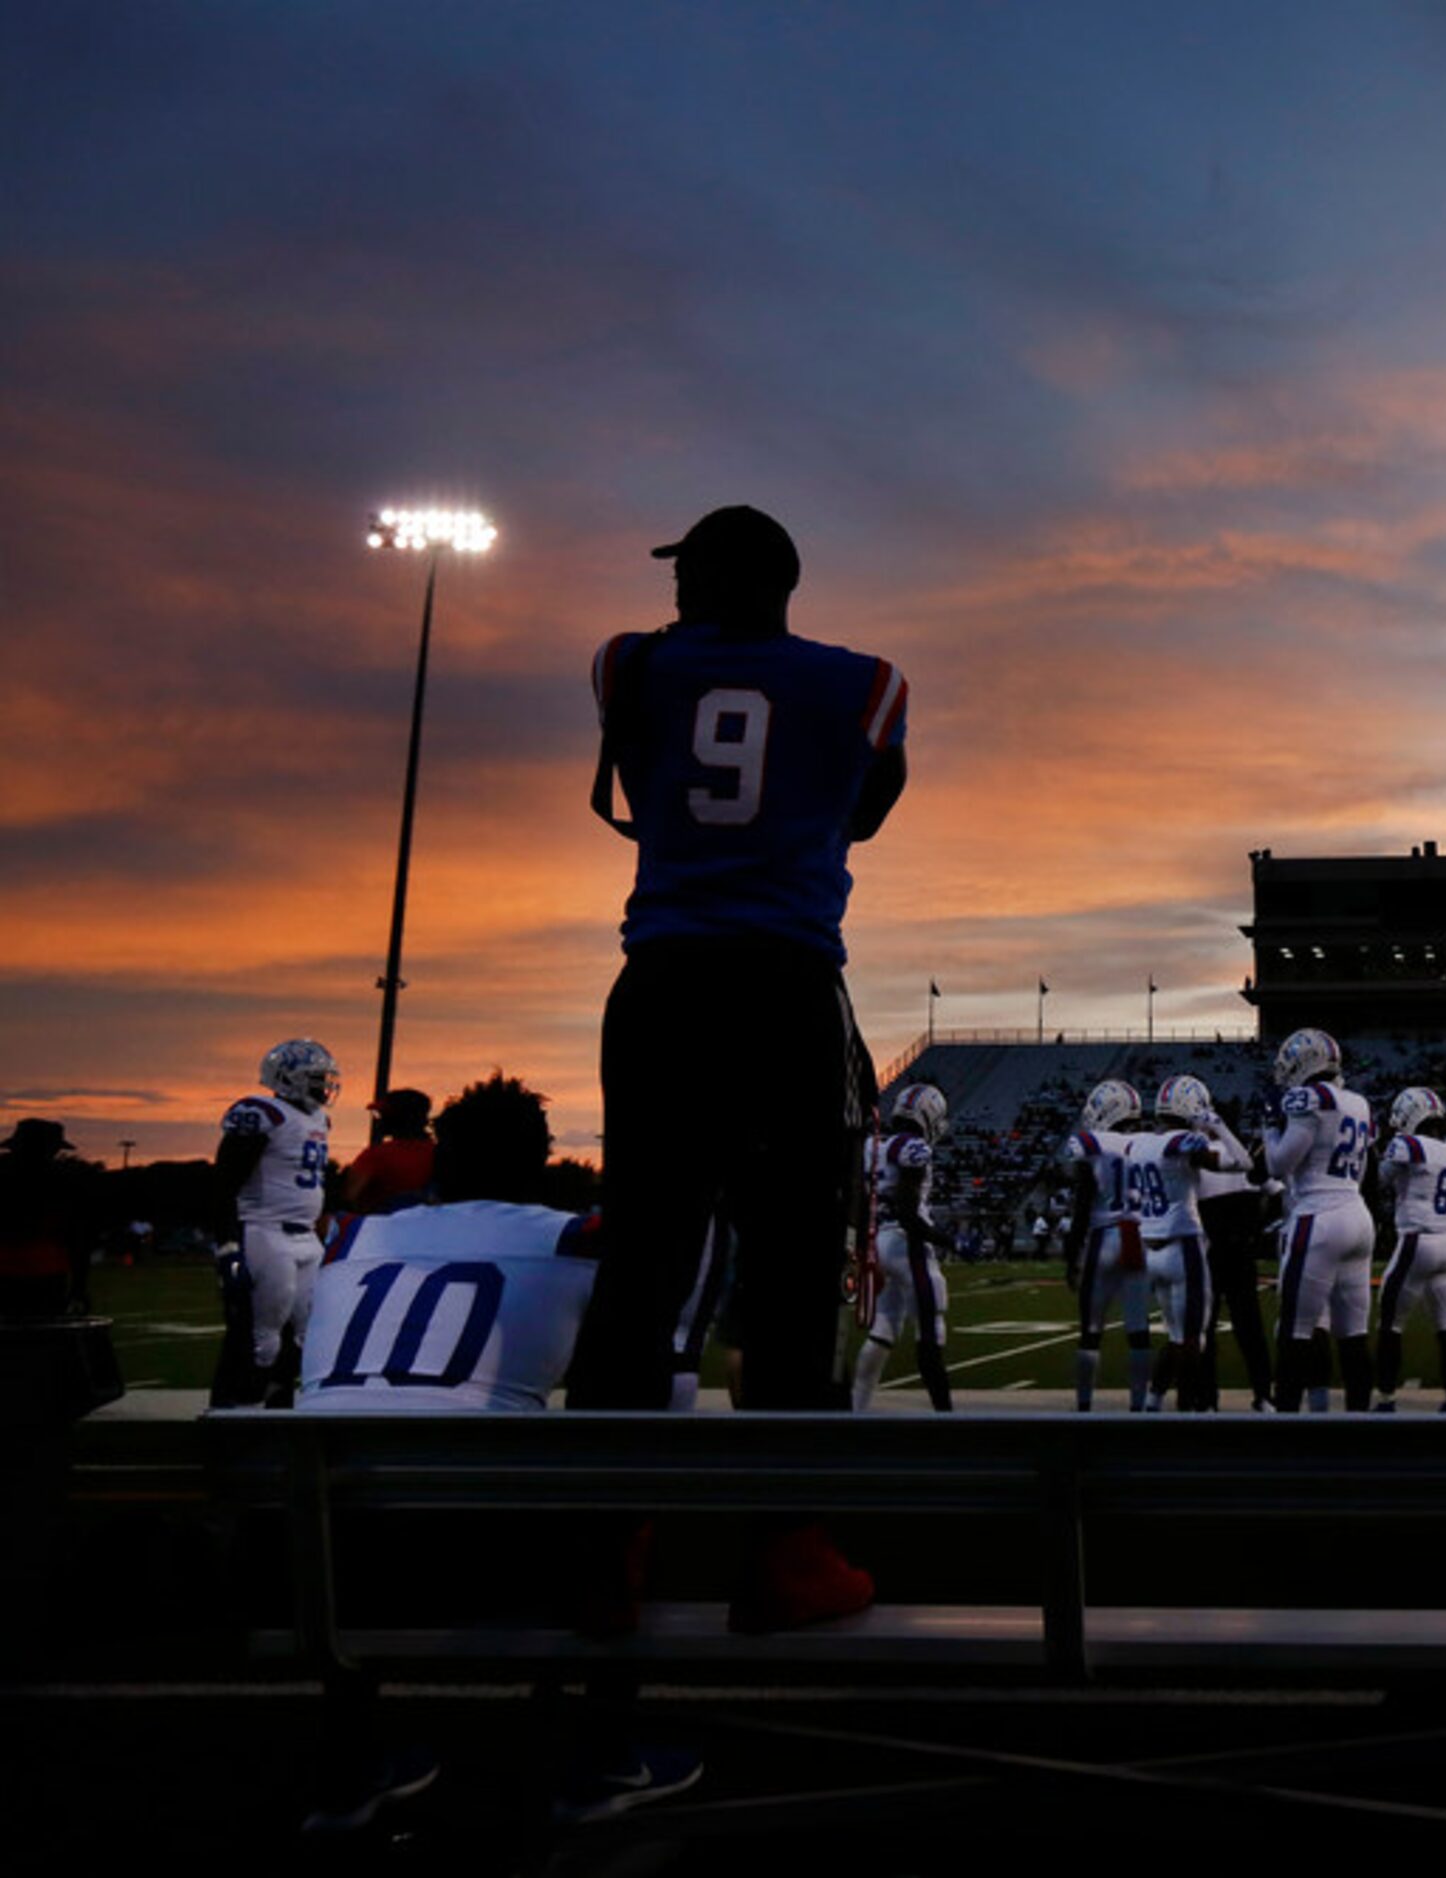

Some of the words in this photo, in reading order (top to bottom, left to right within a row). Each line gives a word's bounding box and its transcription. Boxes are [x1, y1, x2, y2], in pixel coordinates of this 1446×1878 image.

[686, 683, 772, 827] 9
[1284, 1090, 1309, 1111] 23
[319, 1262, 505, 1388] 10
